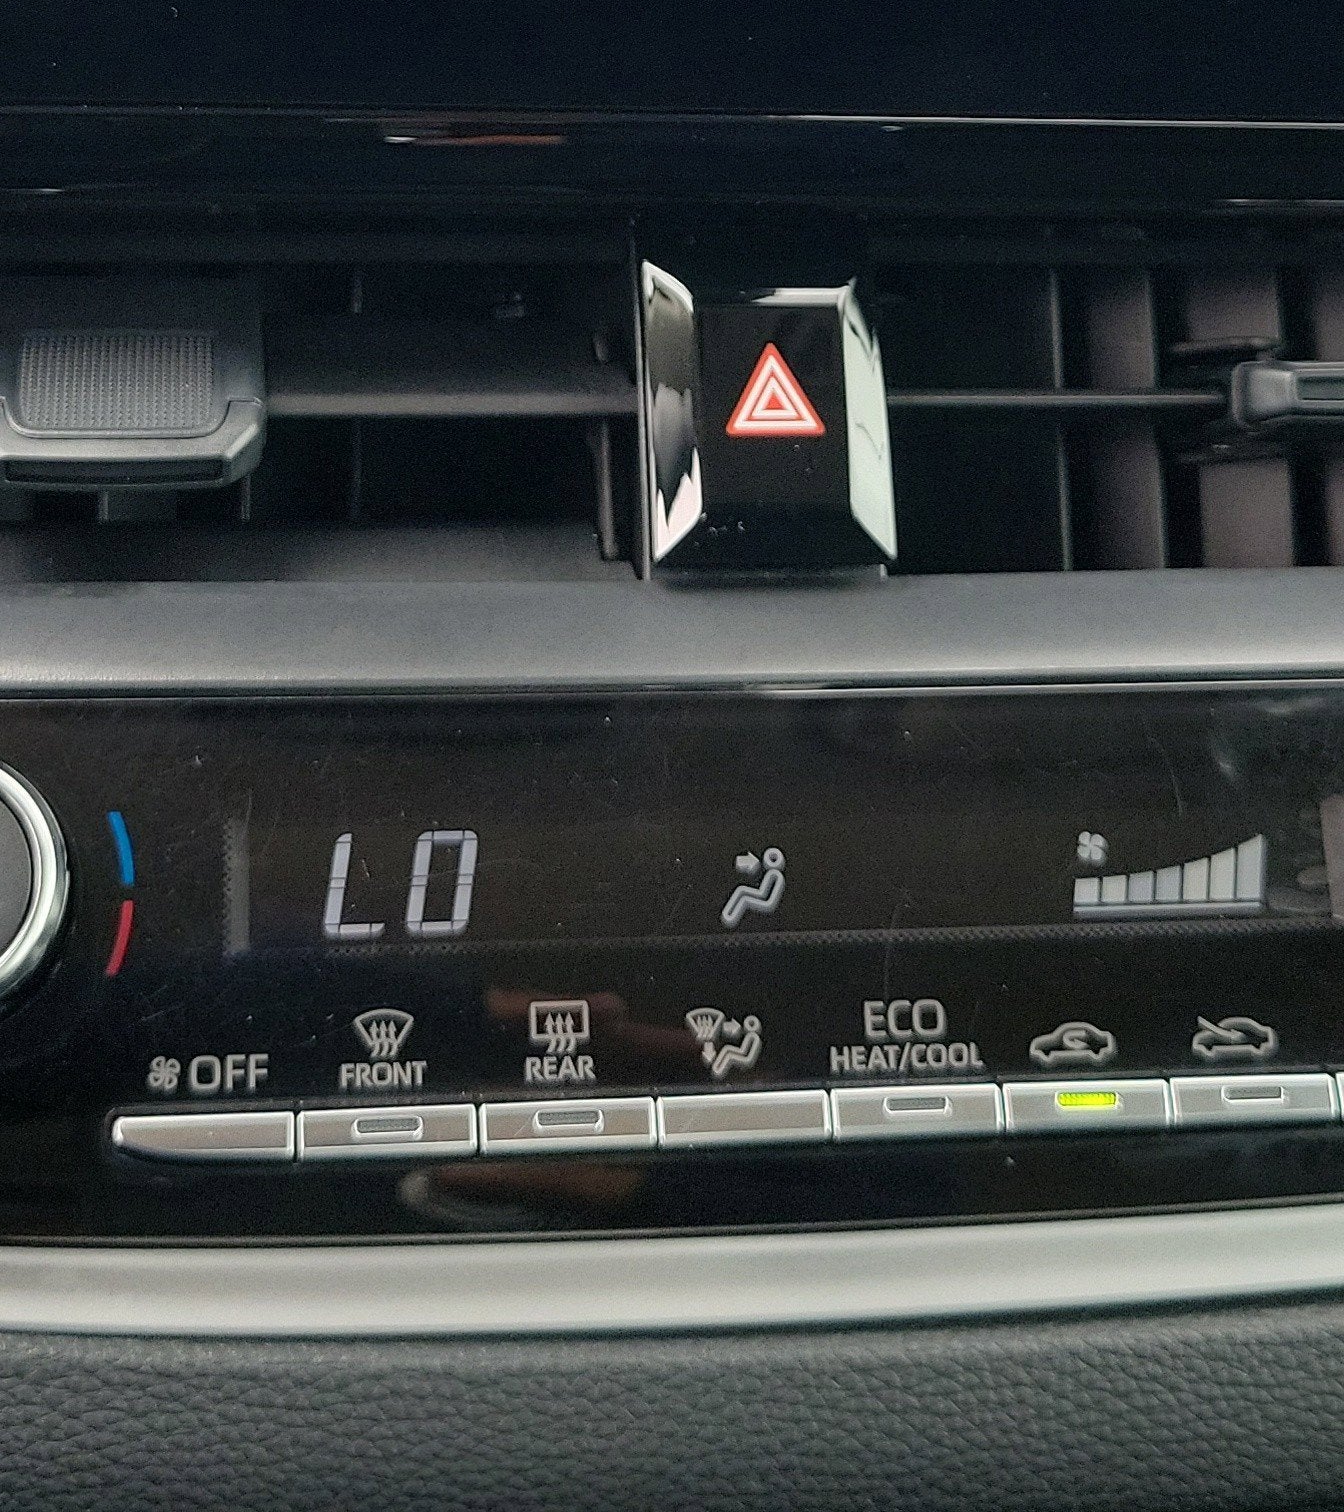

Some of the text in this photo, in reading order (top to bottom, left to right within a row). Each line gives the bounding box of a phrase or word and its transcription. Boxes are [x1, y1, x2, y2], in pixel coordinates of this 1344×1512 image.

[322, 829, 479, 940] LO
[862, 997, 948, 1039] ECO
[187, 1052, 270, 1093] OFF
[339, 1059, 429, 1089] FRONT
[523, 1053, 596, 1084] REAR
[828, 1042, 985, 1075] HEAT/COOL
